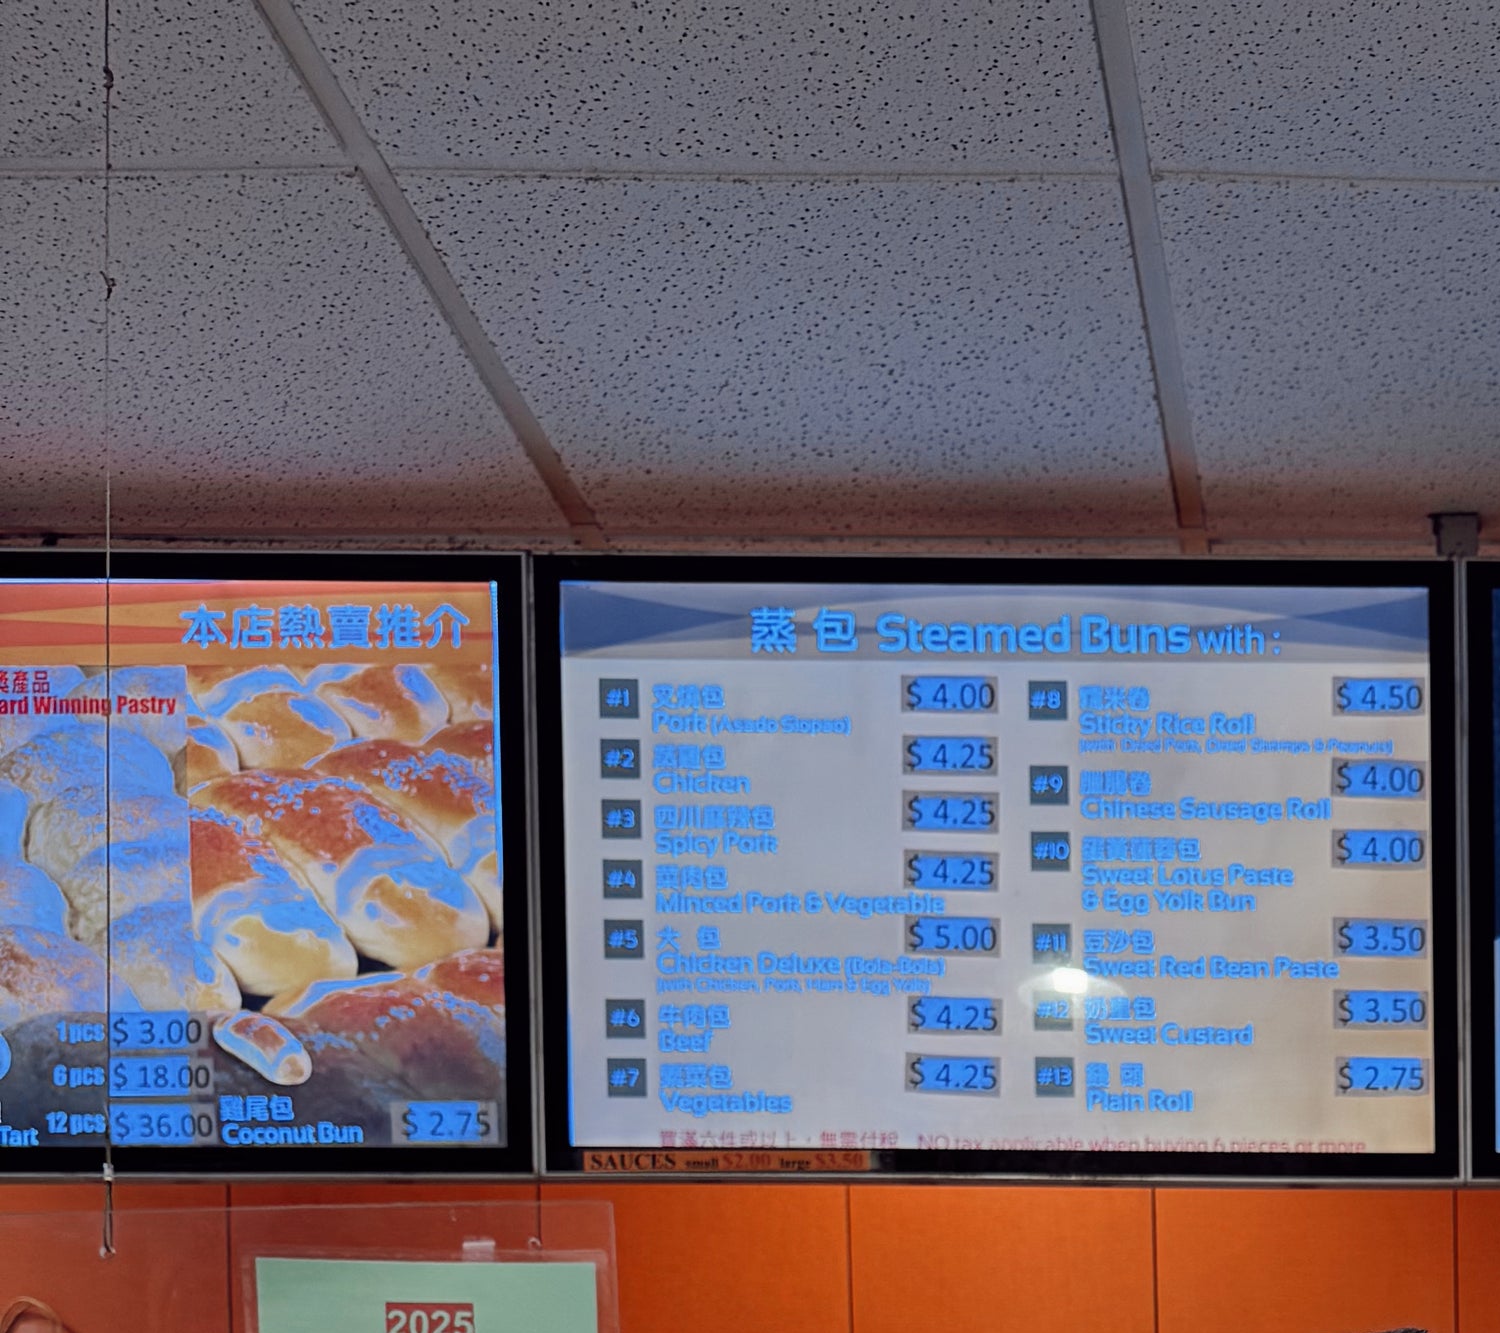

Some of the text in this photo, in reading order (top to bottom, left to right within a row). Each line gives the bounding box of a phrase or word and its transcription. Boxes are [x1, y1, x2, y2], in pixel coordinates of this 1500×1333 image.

[179, 603, 470, 650] 本店熱賣推介
[875, 612, 1070, 653] Steamed
[1080, 614, 1191, 654] Buns
[1198, 624, 1265, 655] with
[34, 694, 112, 717] Winning
[116, 695, 176, 716] Pastry
[606, 688, 630, 707] #1
[653, 771, 750, 795] Chicken
[1081, 797, 1332, 824] Chinese Sausage Roll
[656, 951, 841, 976] Chicken Deluxe
[1083, 955, 1340, 979] Sweet Red Bean Paste
[1085, 1022, 1254, 1047] Sweet Custard
[659, 1090, 793, 1117] Vegetables
[1085, 1089, 1194, 1112] Plain Roll
[0, 1125, 39, 1147] Tart
[221, 1121, 364, 1145] Coconut Bun
[589, 1153, 677, 1170] SAUCES
